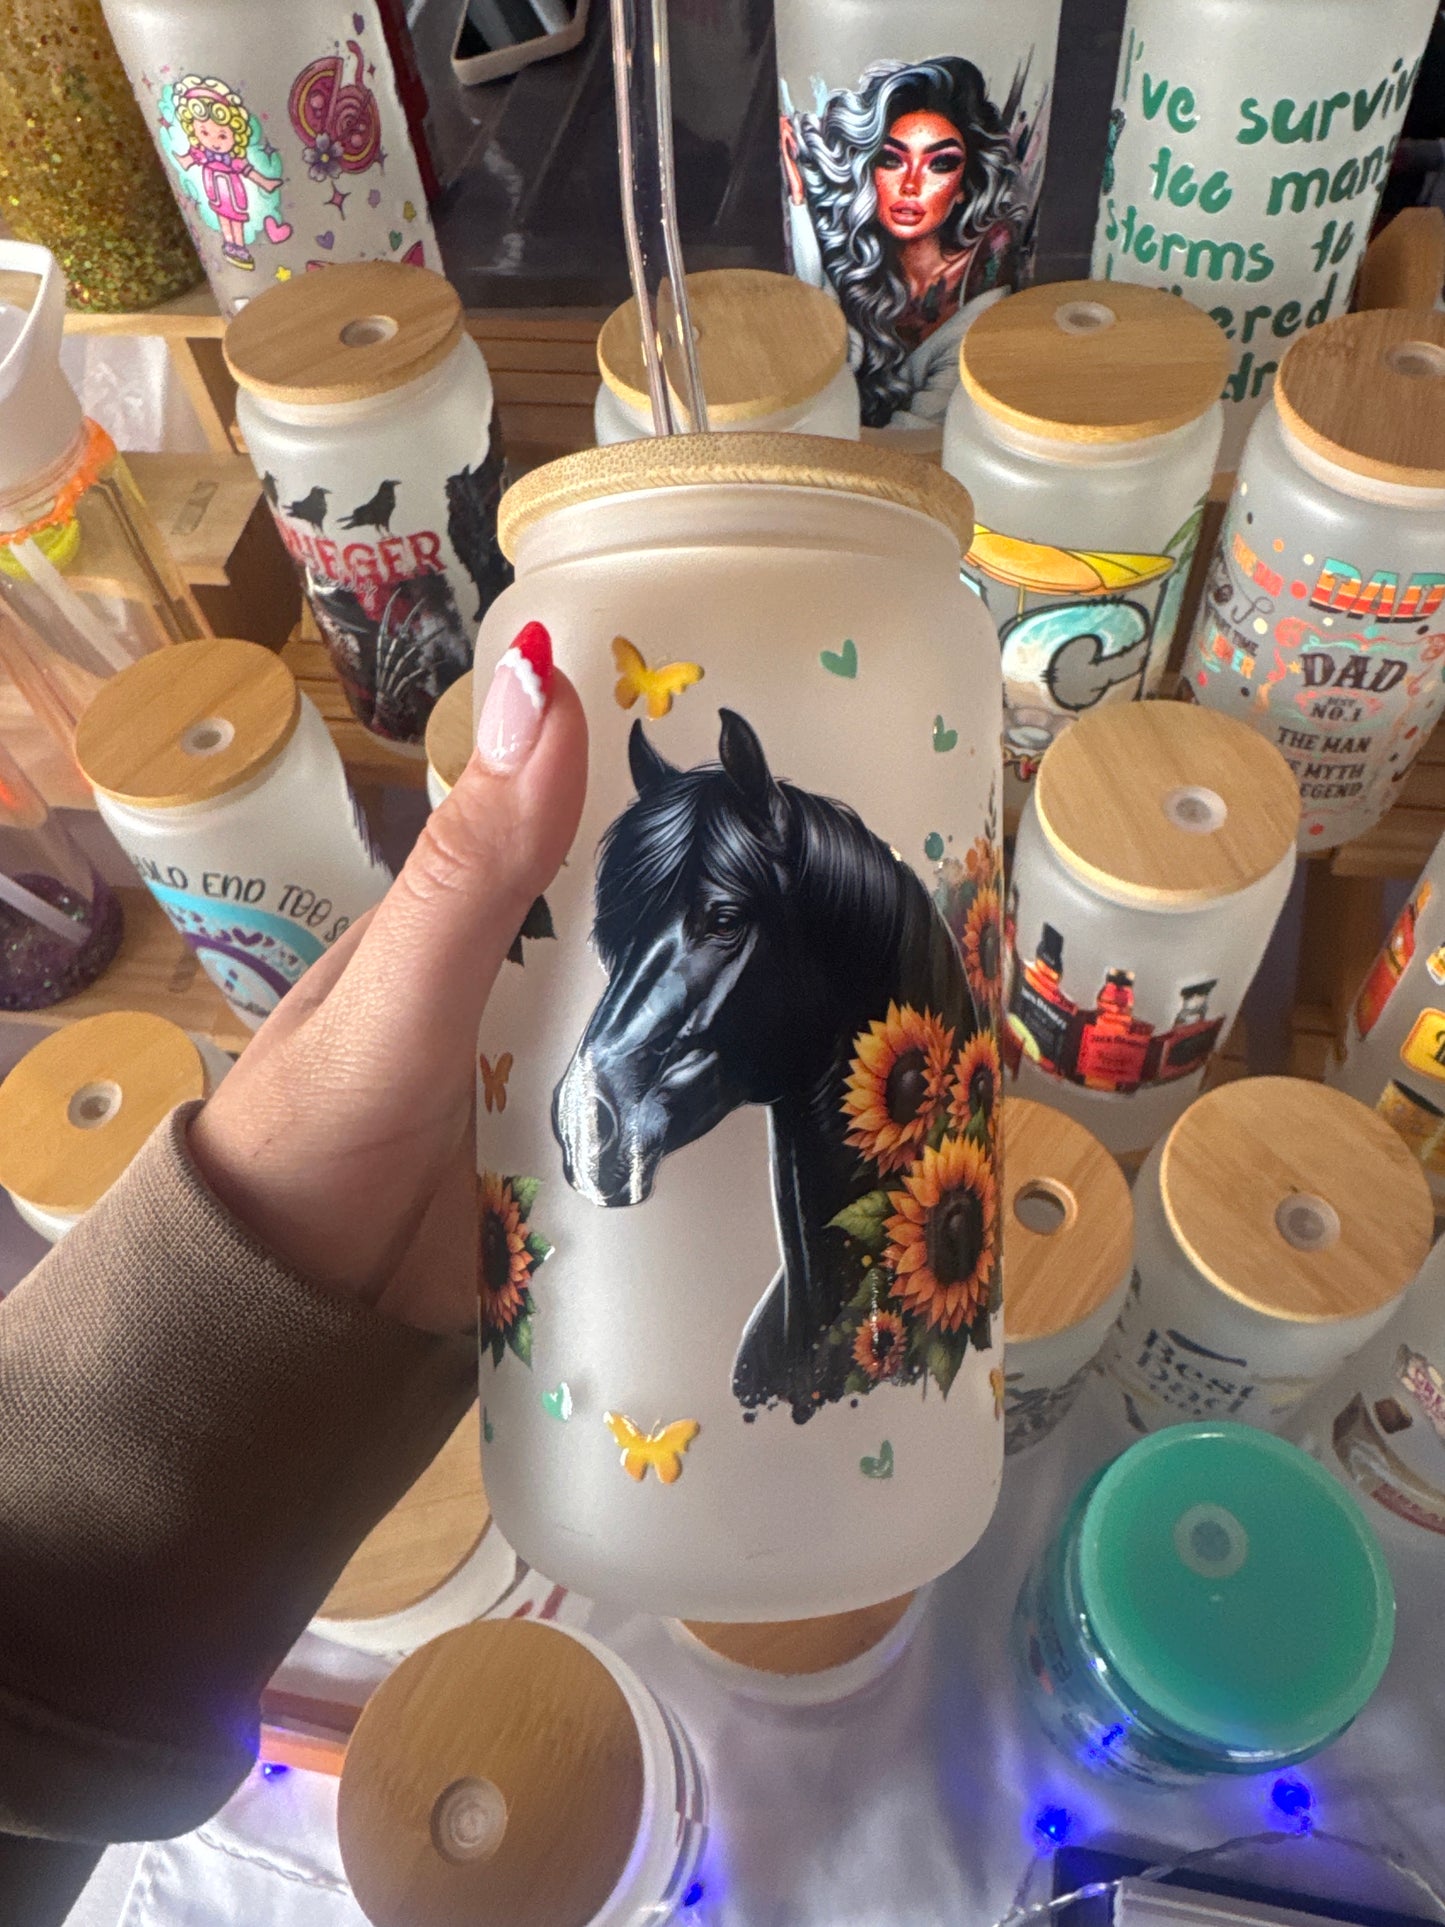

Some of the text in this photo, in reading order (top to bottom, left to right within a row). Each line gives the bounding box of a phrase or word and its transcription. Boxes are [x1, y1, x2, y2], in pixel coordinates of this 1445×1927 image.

[1312, 219, 1354, 273] to
[1308, 556, 1445, 624] DAD
[1300, 652, 1408, 692] DAD
[1278, 726, 1372, 754] THE MAN
[1303, 762, 1366, 780] MYTH
[1299, 782, 1363, 800] EGEND
[202, 871, 266, 904] END
